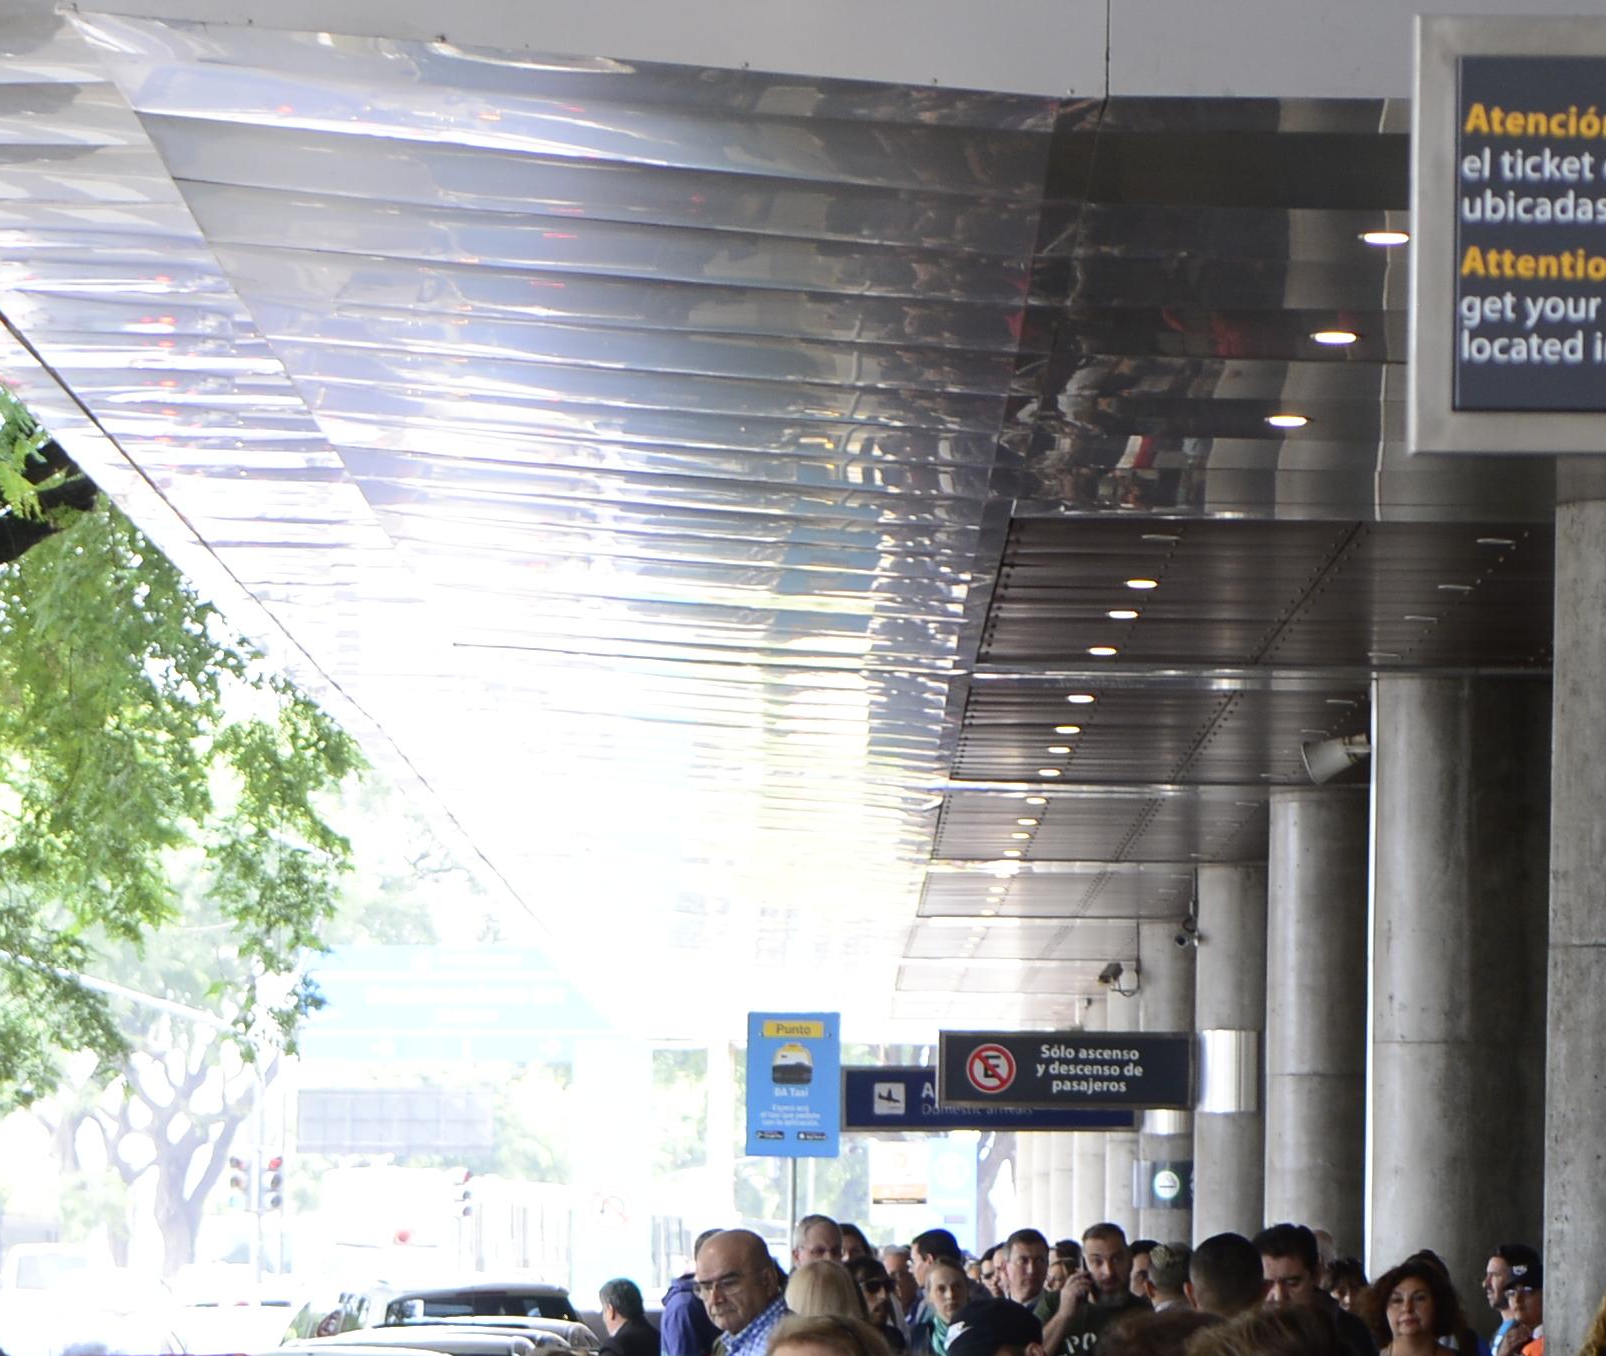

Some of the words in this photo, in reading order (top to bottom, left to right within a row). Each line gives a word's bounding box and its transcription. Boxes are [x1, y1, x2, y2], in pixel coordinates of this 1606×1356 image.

[1462, 147, 1491, 180] el
[1500, 147, 1595, 181] ticket
[1460, 292, 1516, 328] get
[1525, 297, 1602, 330] your
[1460, 328, 1584, 363] located
[776, 1024, 811, 1035] Punto
[1041, 1044, 1076, 1059] Sólo
[1079, 1047, 1140, 1061] ascenso
[1036, 1064, 1047, 1078] y
[1049, 1061, 1121, 1077] descenso
[1123, 1062, 1144, 1077] de
[1052, 1078, 1128, 1093] pasajeros
